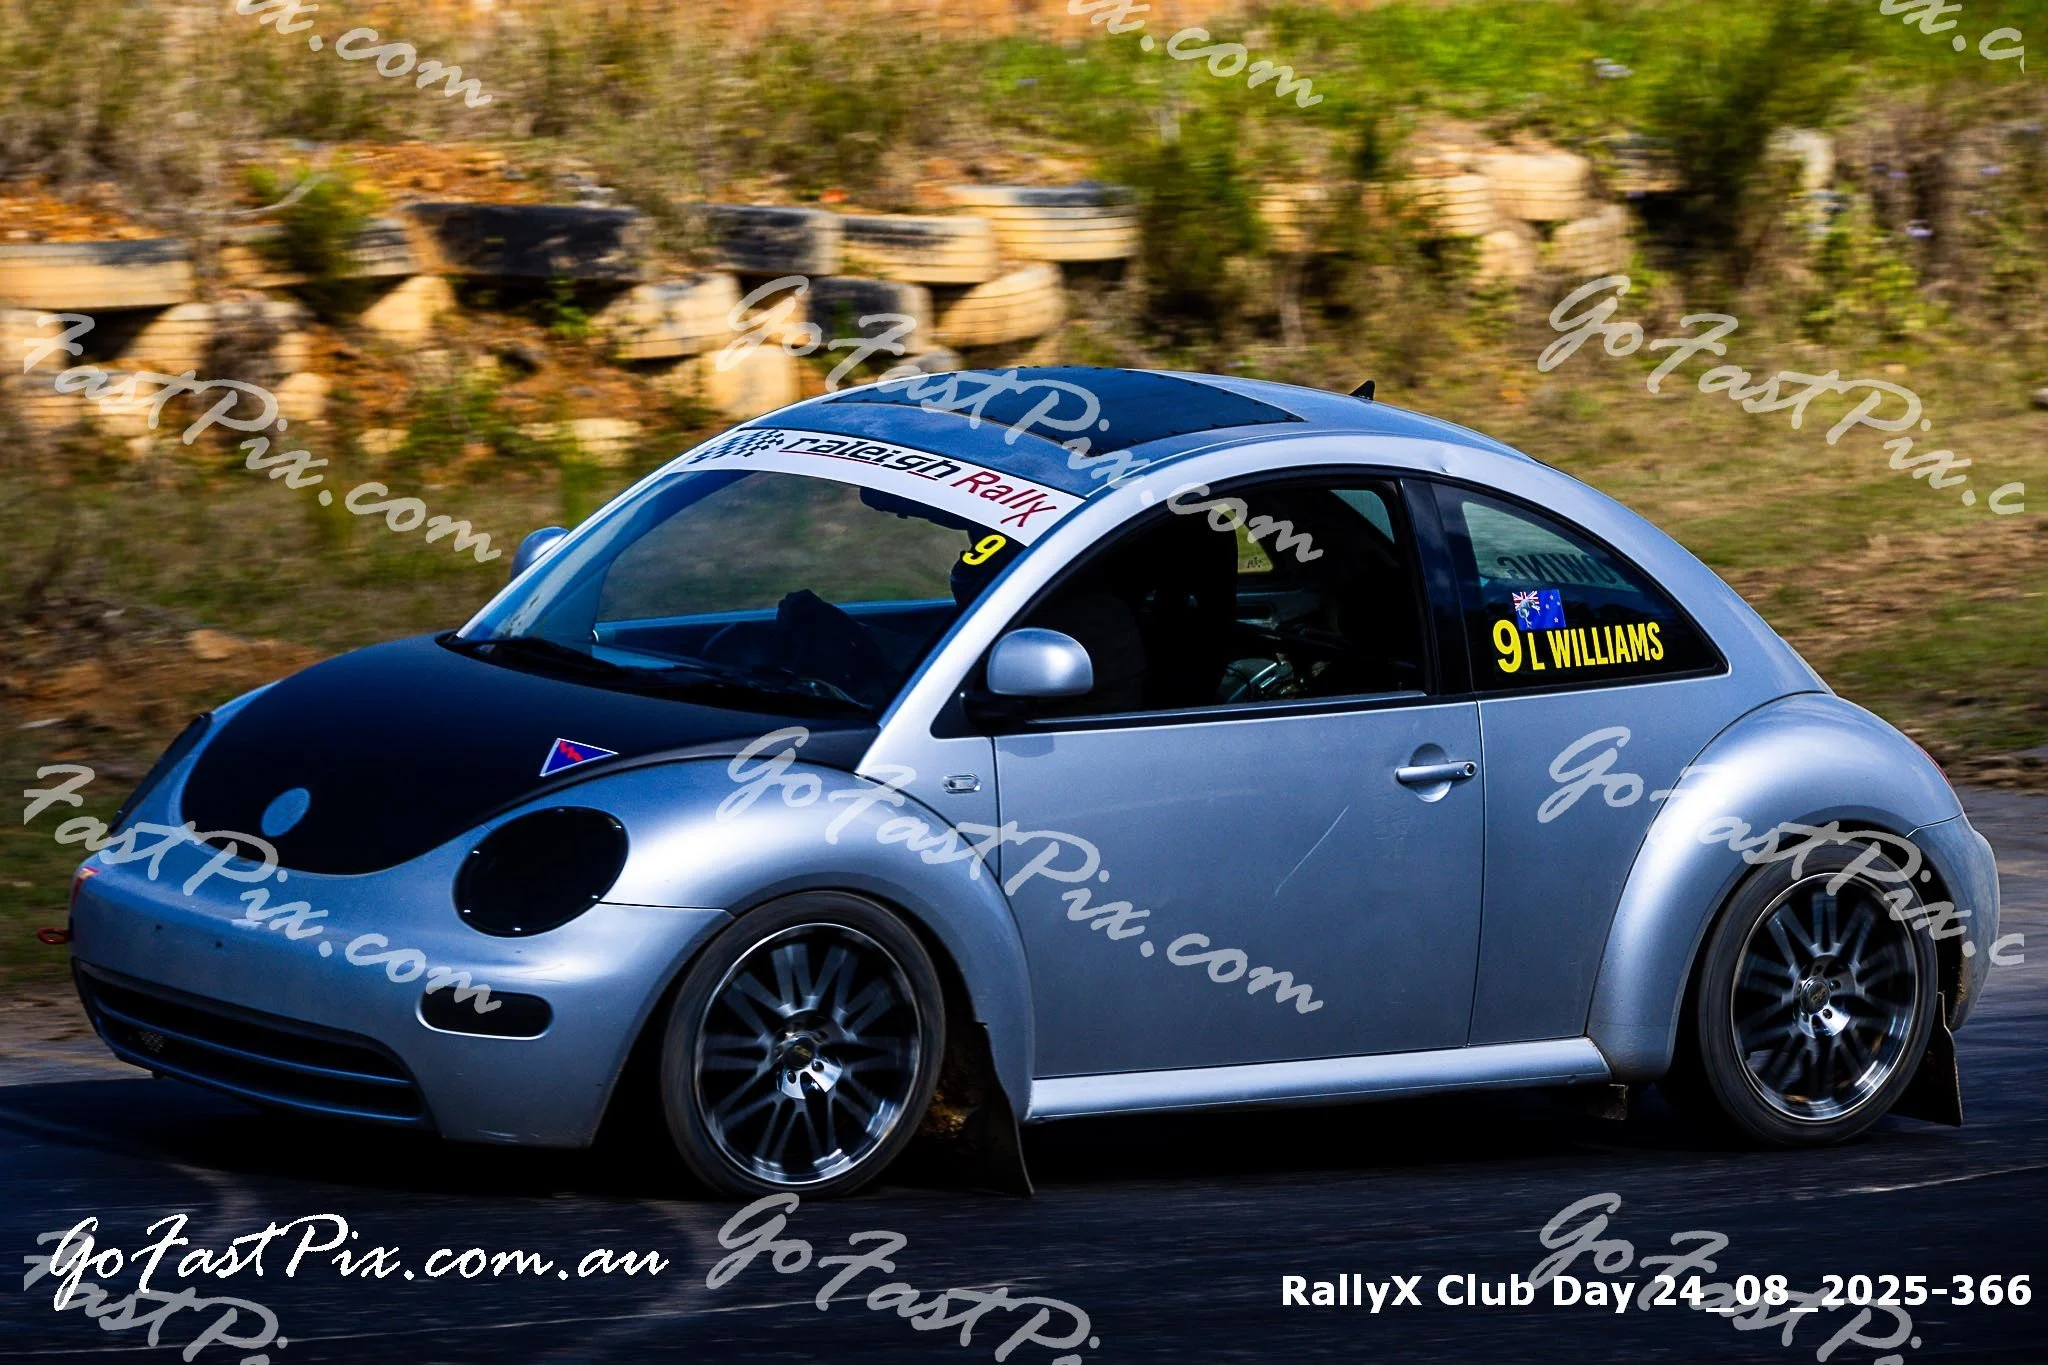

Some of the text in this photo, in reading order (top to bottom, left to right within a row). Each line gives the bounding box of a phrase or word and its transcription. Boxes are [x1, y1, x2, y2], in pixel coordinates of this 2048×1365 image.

[781, 436, 1057, 528] raleigh Rally
[961, 533, 1008, 567] 9
[1492, 619, 1664, 673] 9 L WILLIAMS
